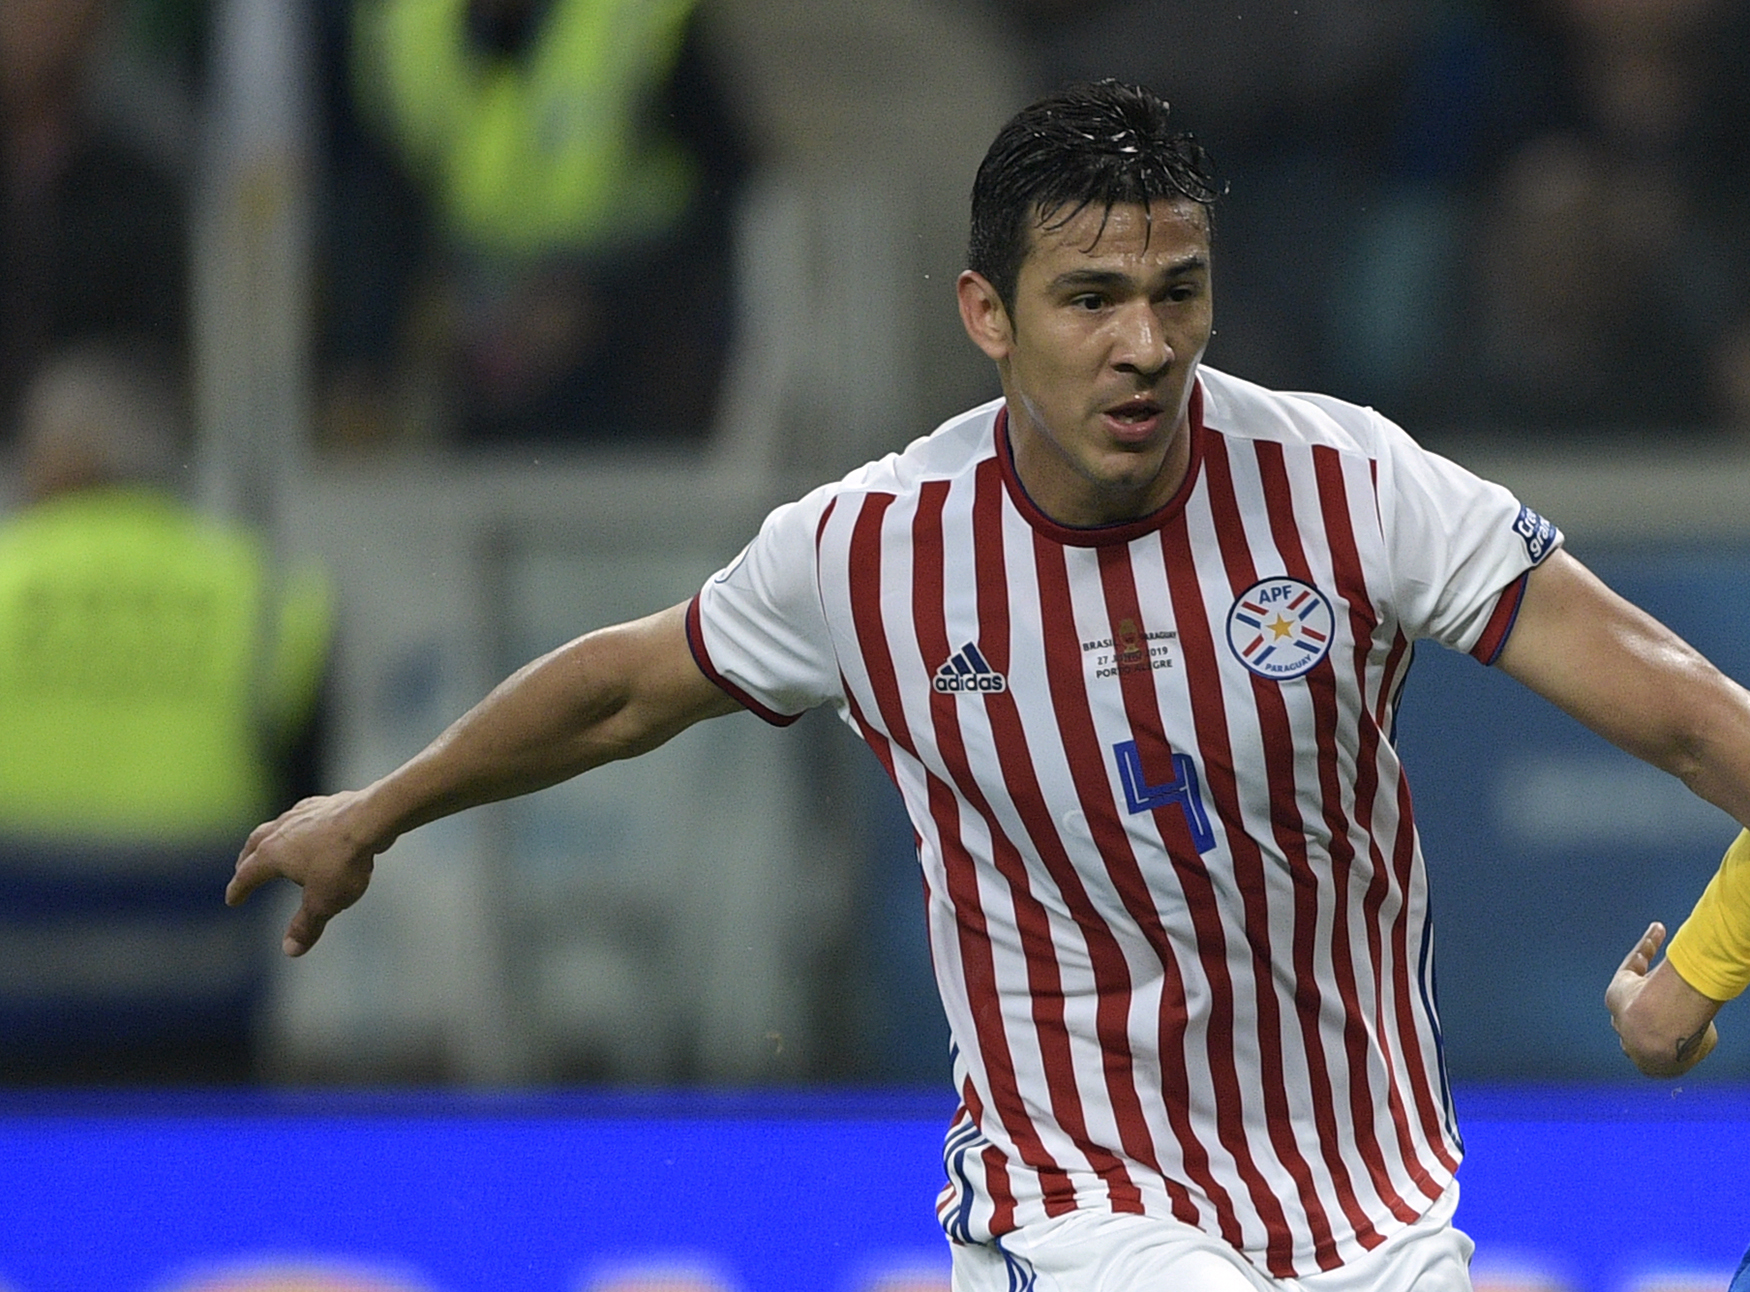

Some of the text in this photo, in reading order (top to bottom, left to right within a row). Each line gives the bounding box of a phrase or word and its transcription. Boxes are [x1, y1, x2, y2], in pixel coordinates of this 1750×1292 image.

[1259, 585, 1292, 605] APF
[1097, 656, 1108, 666] 27
[1265, 654, 1312, 672] PARAGUAY
[936, 673, 1003, 691] adidas
[1112, 740, 1217, 855] 4
